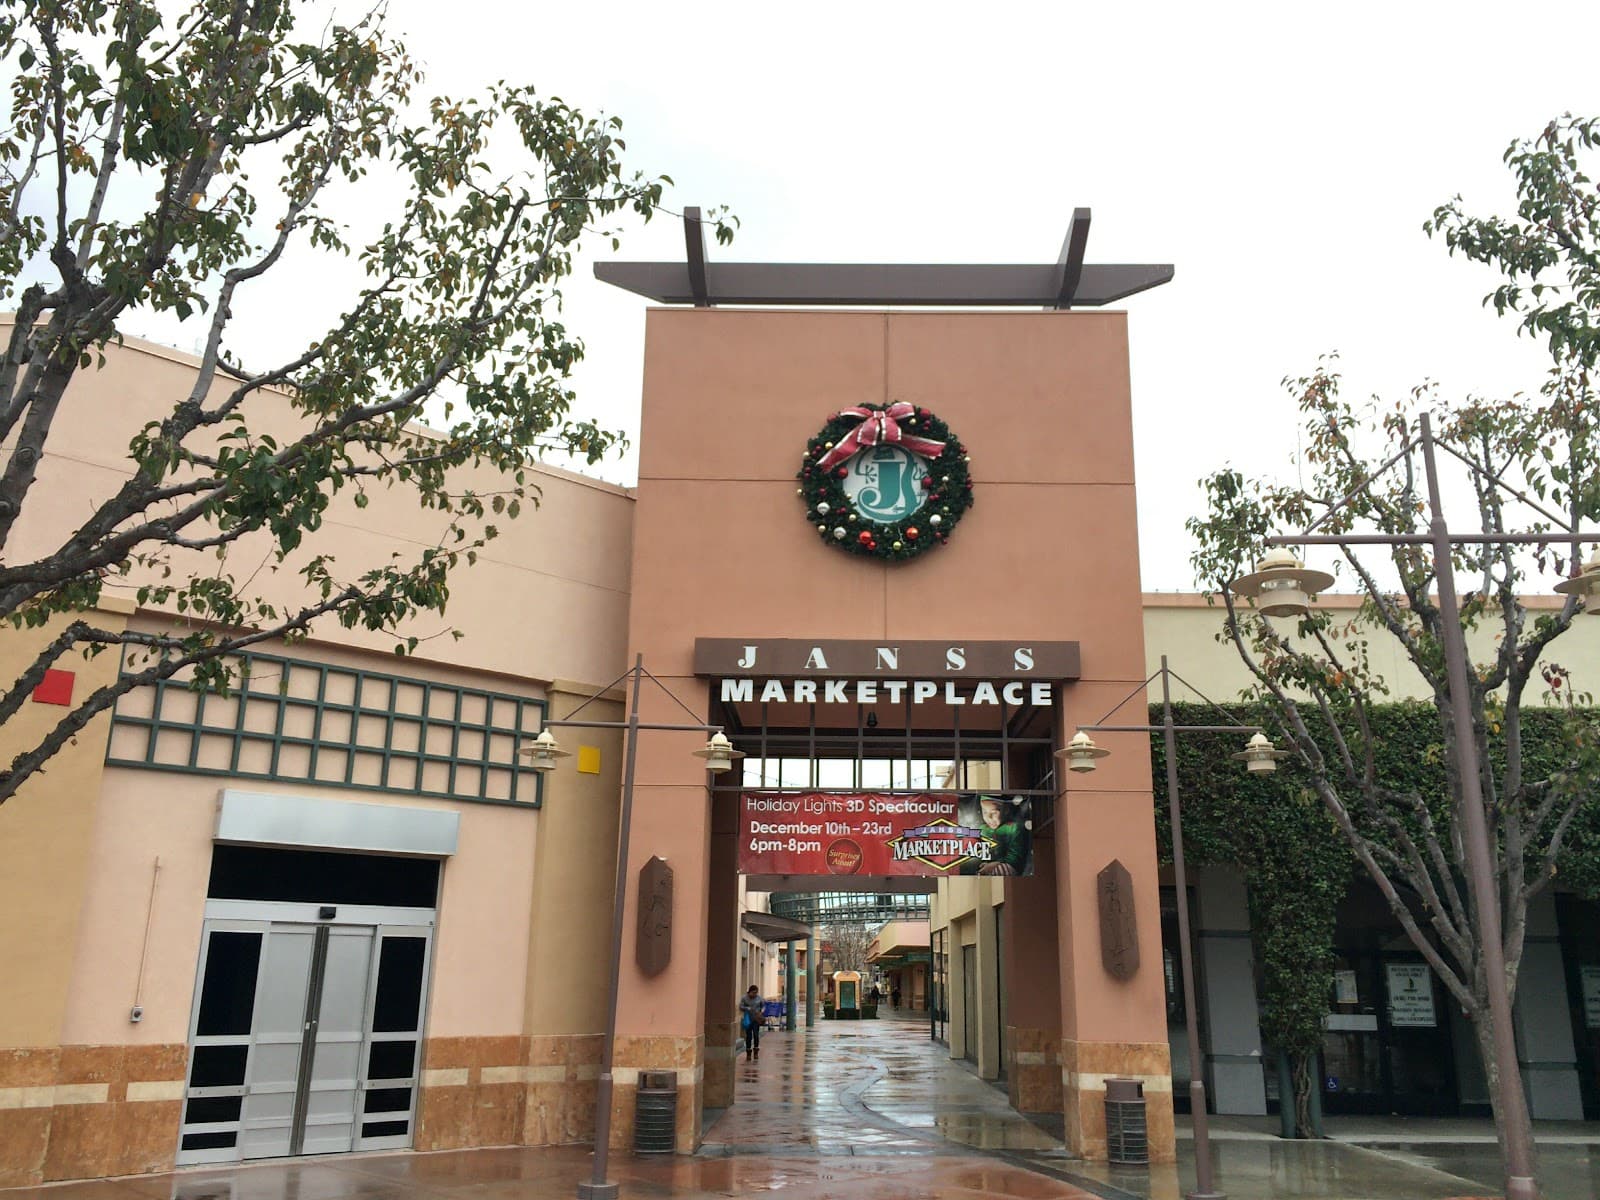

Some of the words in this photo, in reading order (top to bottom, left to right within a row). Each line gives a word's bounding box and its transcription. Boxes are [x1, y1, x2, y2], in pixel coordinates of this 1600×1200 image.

[737, 645, 1035, 671] JANSS
[720, 679, 1053, 706] MARKETPLACE
[747, 797, 801, 815] Holiday
[804, 798, 843, 815] Lights
[846, 800, 865, 813] 3D
[868, 799, 955, 815] Spectacular
[750, 820, 822, 835] December
[825, 821, 851, 835] 10th
[862, 821, 892, 835] 23rd
[749, 838, 821, 854] 6pm-8pm
[893, 839, 992, 861] MARKETPLACE
